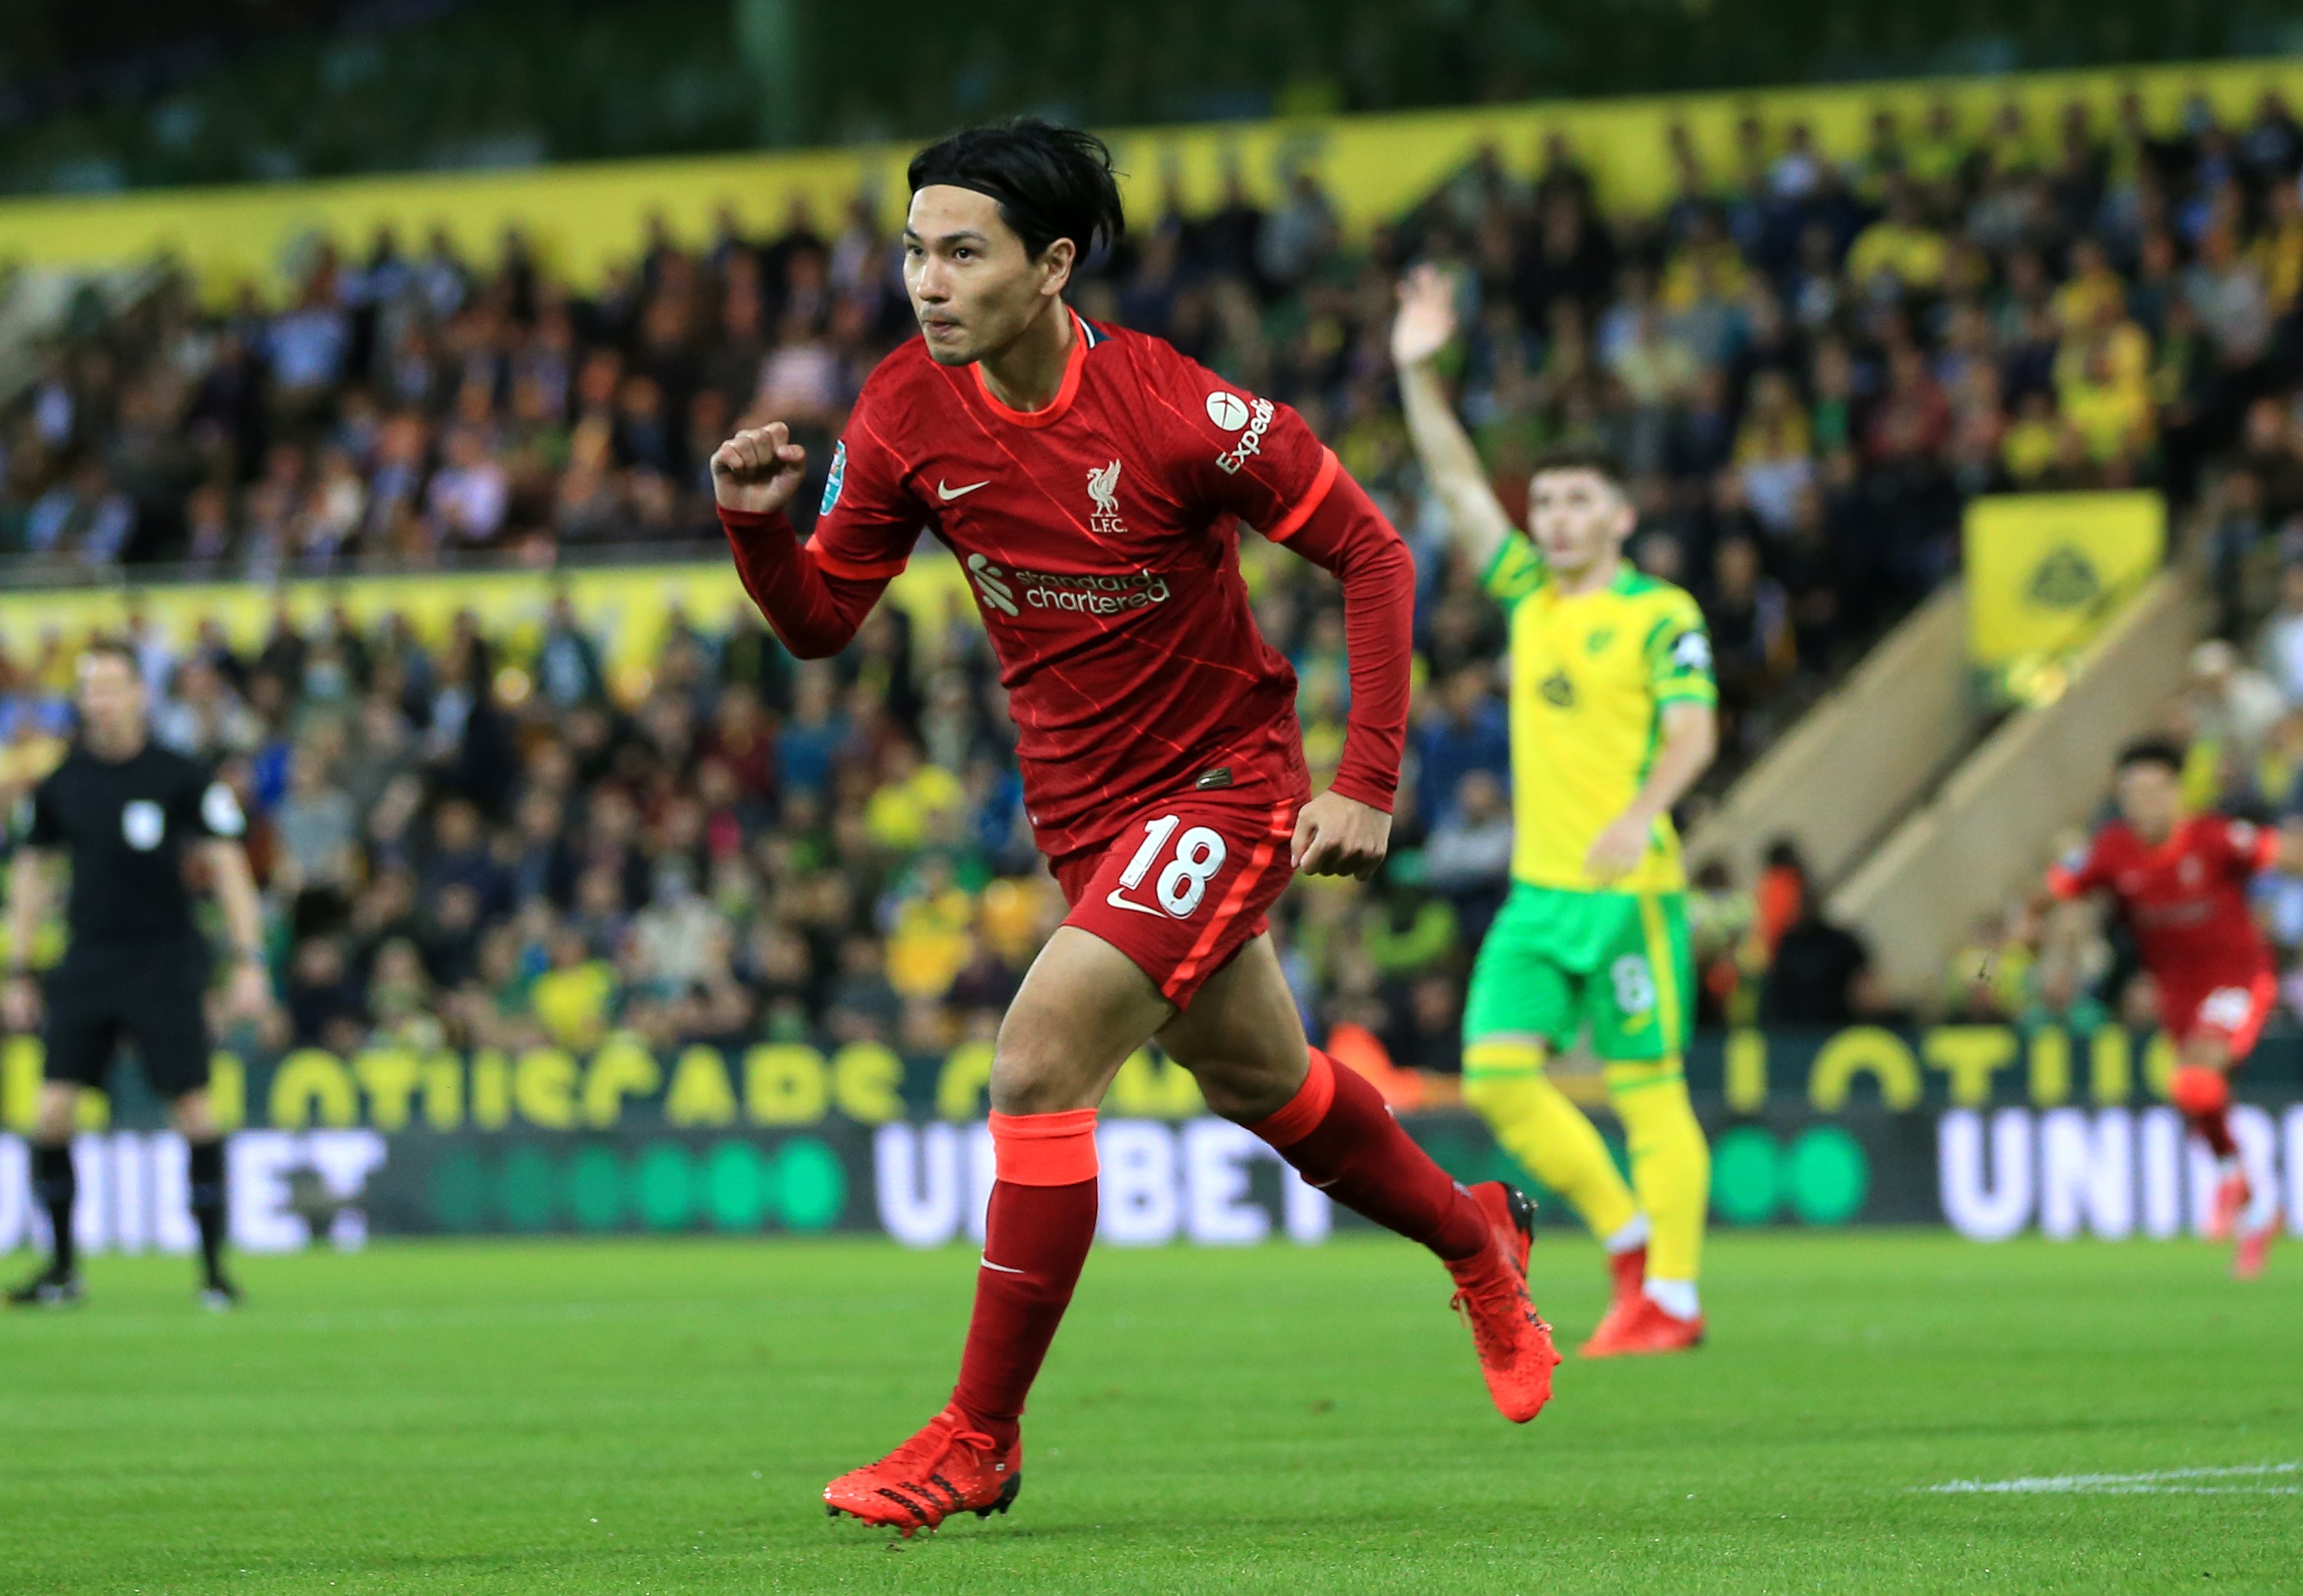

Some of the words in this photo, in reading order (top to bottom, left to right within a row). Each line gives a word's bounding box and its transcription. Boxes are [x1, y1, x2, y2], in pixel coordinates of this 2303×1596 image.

[1015, 569, 1153, 592] standard
[1026, 576, 1171, 614] chartered
[1119, 813, 1228, 920] 18
[1610, 953, 1656, 1014] 8
